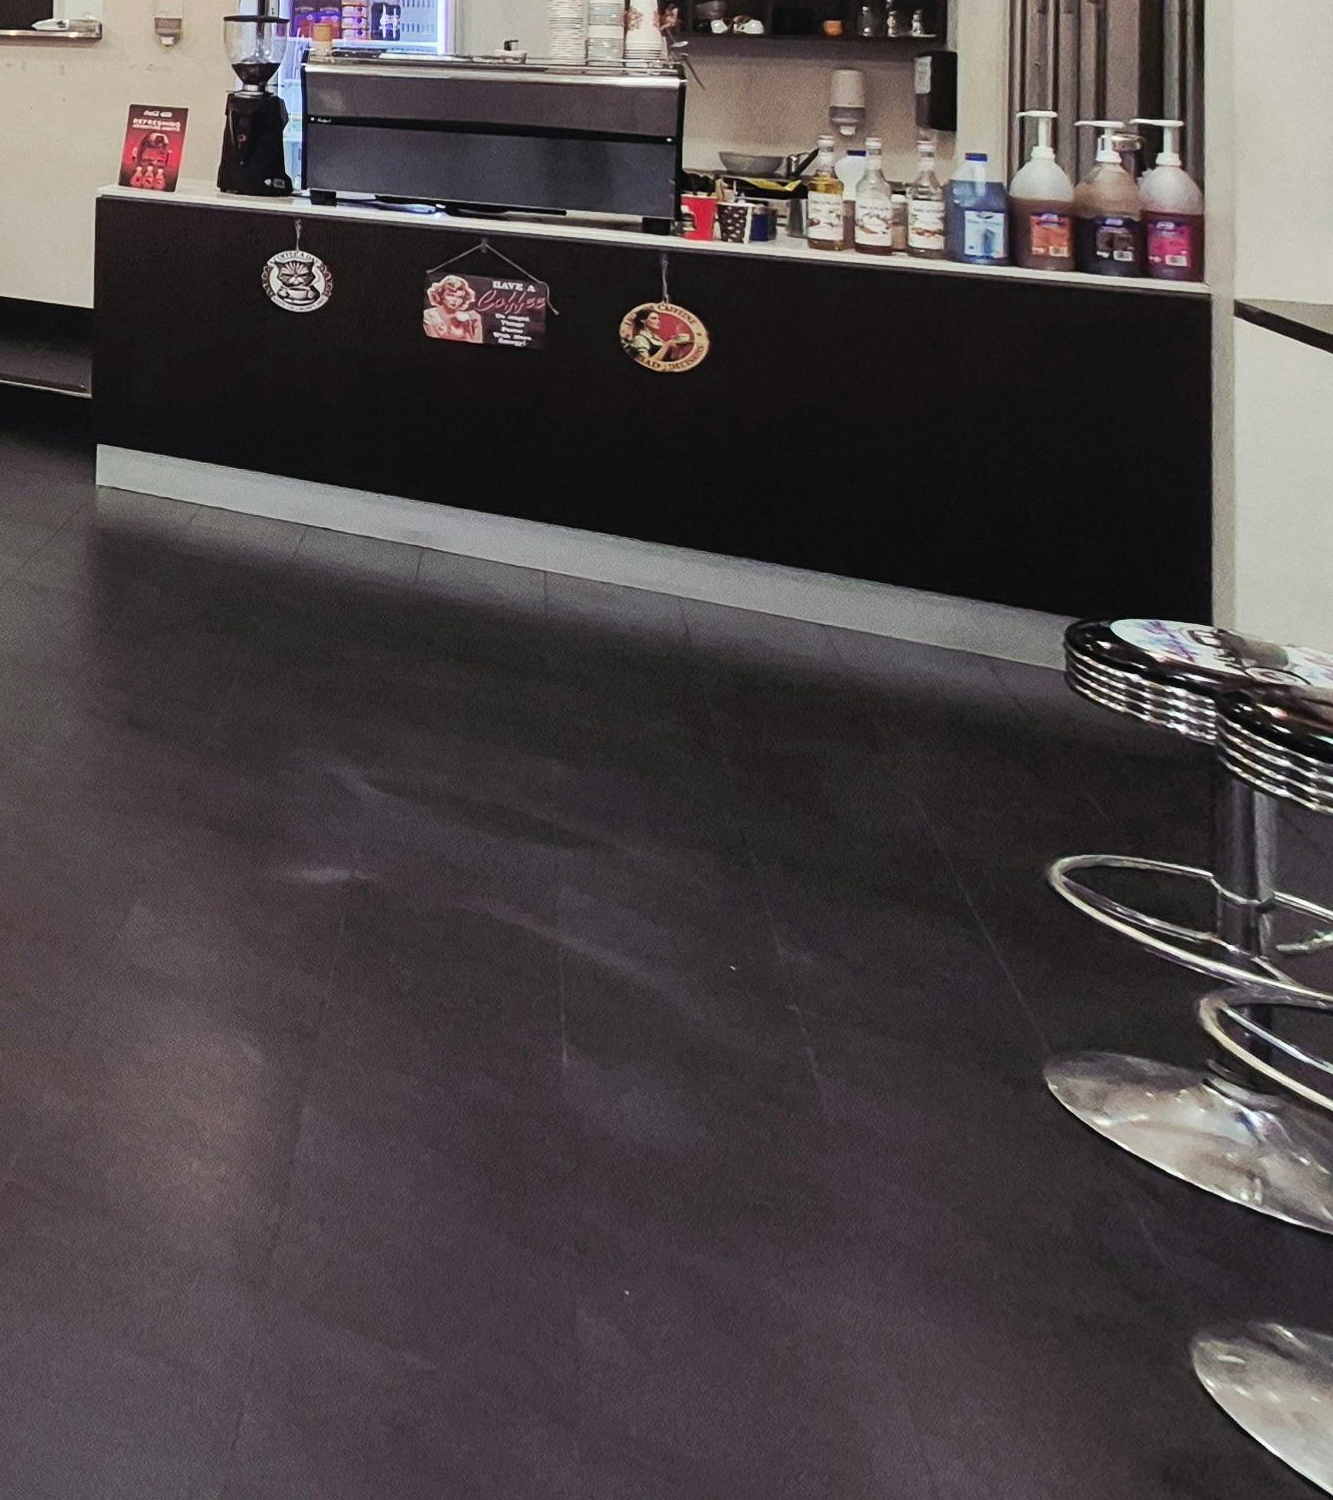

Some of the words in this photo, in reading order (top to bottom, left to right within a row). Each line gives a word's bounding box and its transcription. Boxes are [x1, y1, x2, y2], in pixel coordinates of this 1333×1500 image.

[492, 280, 524, 292] HAVE
[526, 284, 536, 292] A
[475, 289, 547, 315] Coffee
